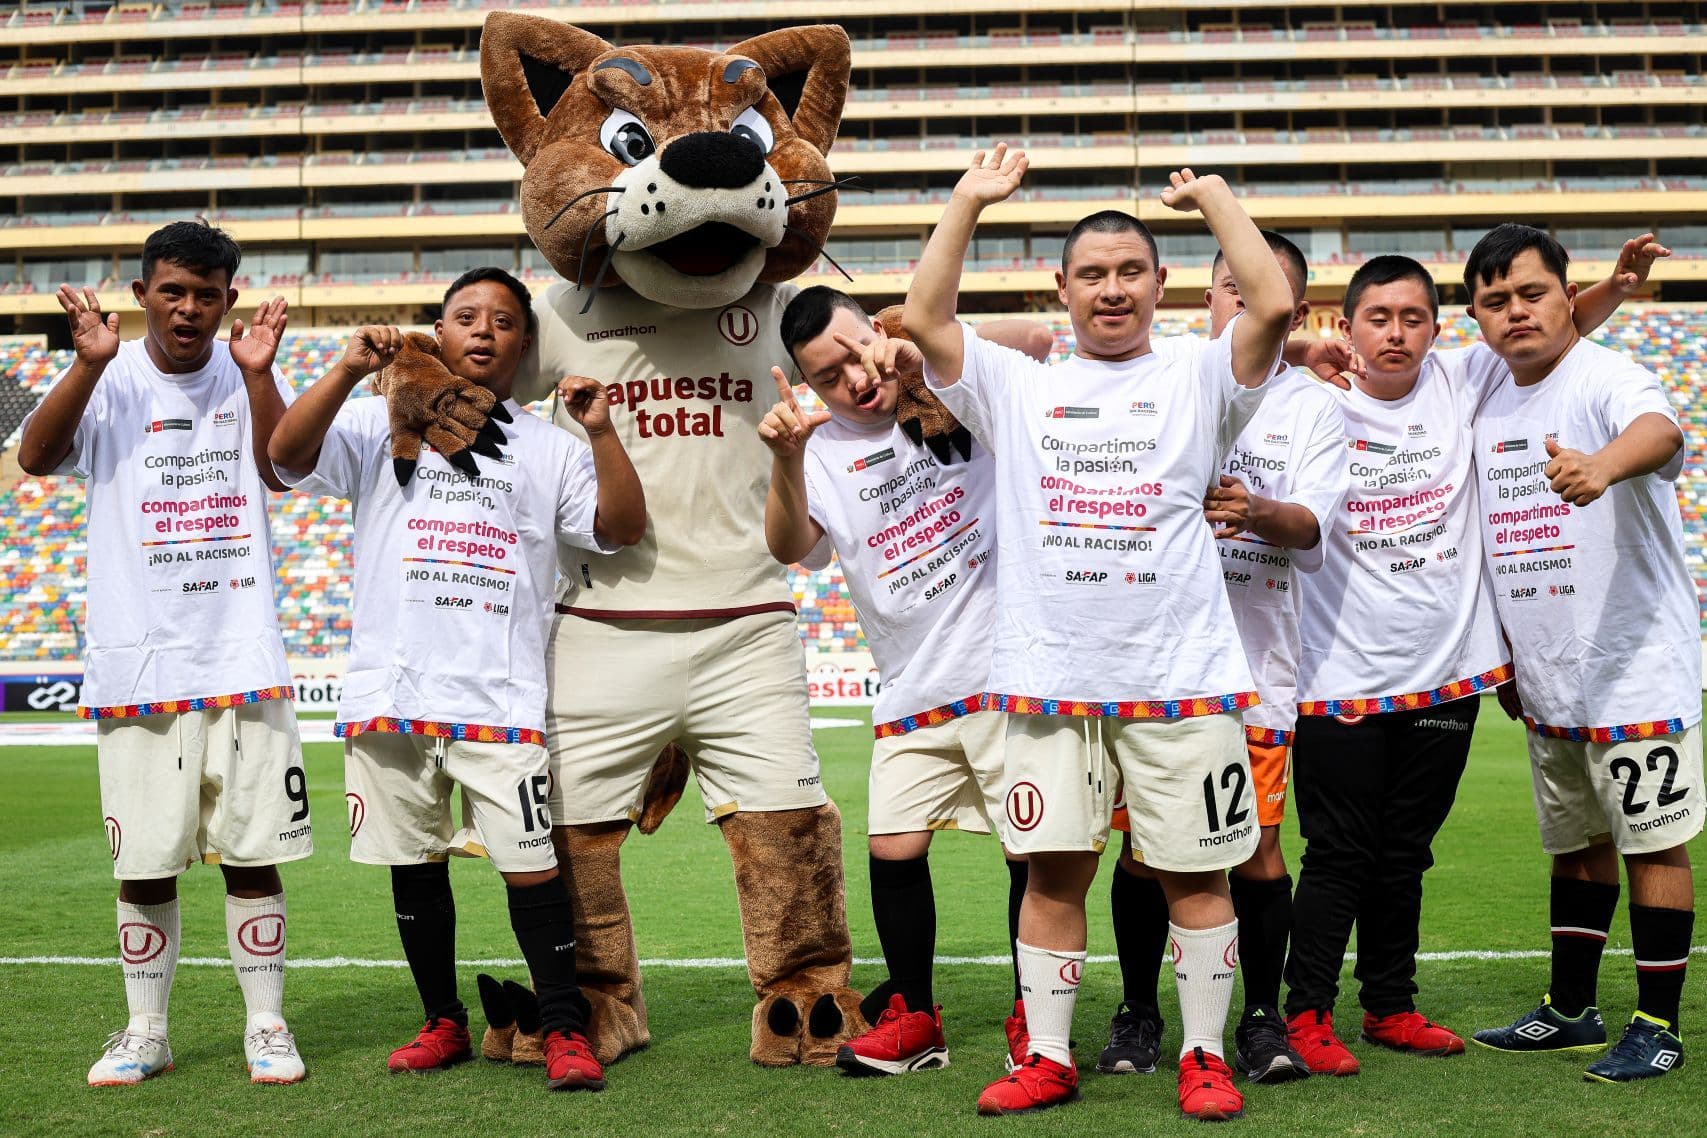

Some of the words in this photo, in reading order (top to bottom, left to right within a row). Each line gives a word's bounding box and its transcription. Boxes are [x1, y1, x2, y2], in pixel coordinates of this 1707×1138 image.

[586, 323, 657, 341] marathon
[606, 372, 754, 412] apuesta
[215, 411, 234, 420] PERÚ
[1131, 401, 1155, 409] PERÚ
[636, 404, 724, 439] total
[1041, 434, 1157, 456] Compartimos
[144, 448, 240, 470] Compartimos
[1055, 455, 1070, 472] la
[1350, 447, 1441, 477] Comartimos
[161, 472, 174, 486] la
[859, 455, 937, 502] Compartimo
[1040, 475, 1163, 497] compartimos
[430, 484, 443, 500] la
[1347, 483, 1454, 514] compartimos
[1498, 484, 1509, 499] la
[141, 492, 248, 517] compartimos
[879, 501, 890, 515] la
[1049, 494, 1064, 512] el
[1067, 499, 1147, 519] respeto
[1488, 503, 1571, 526] compartimos
[155, 517, 172, 533] el
[175, 513, 240, 533] respeto
[867, 486, 965, 548] compartimos
[1359, 516, 1375, 531] el
[1379, 501, 1446, 531] respeto
[407, 518, 518, 545] compartimos
[884, 542, 900, 561] el
[901, 510, 961, 553] respeto
[1496, 529, 1507, 544] el
[1510, 524, 1560, 544] respeto
[417, 535, 435, 551] el
[437, 539, 506, 560] respeto
[1042, 534, 1063, 548] ¡NO
[1064, 536, 1081, 549] AL
[1084, 537, 1153, 552] RACISMO!
[1355, 540, 1378, 553] ¡NO
[1380, 538, 1396, 549] AL
[1444, 547, 1458, 560] LIGA
[148, 552, 173, 567] ¡NO
[176, 551, 193, 562] AL
[196, 546, 250, 561] RACISMO!
[888, 575, 909, 595] ¡NO
[911, 568, 928, 583] AL
[927, 528, 981, 573] RACISMO!
[1231, 549, 1290, 568] RACISMO!
[1390, 557, 1426, 573] SAFAP
[1508, 564, 1518, 574] AL
[1520, 558, 1572, 573] RACISMO!
[182, 580, 219, 593] SAFAP
[240, 576, 256, 588] LIGA
[406, 569, 430, 582] ¡NO
[432, 571, 449, 582] AL
[452, 573, 510, 591] RACISMO!
[924, 573, 957, 601] SAFAP
[1065, 570, 1108, 583] SAFAP
[1138, 572, 1157, 583] LIGA
[1224, 570, 1252, 583] AFAP
[1510, 587, 1537, 599] SAFAP
[1559, 585, 1575, 595] LIGA
[434, 596, 473, 608] SAFAP
[493, 603, 509, 615] LIGA
[1609, 745, 1690, 815] 22
[285, 766, 309, 823] 9
[518, 775, 551, 832] 15
[1203, 762, 1250, 833] 12
[1630, 808, 1690, 833] marathon
[1199, 825, 1253, 848] marathon
